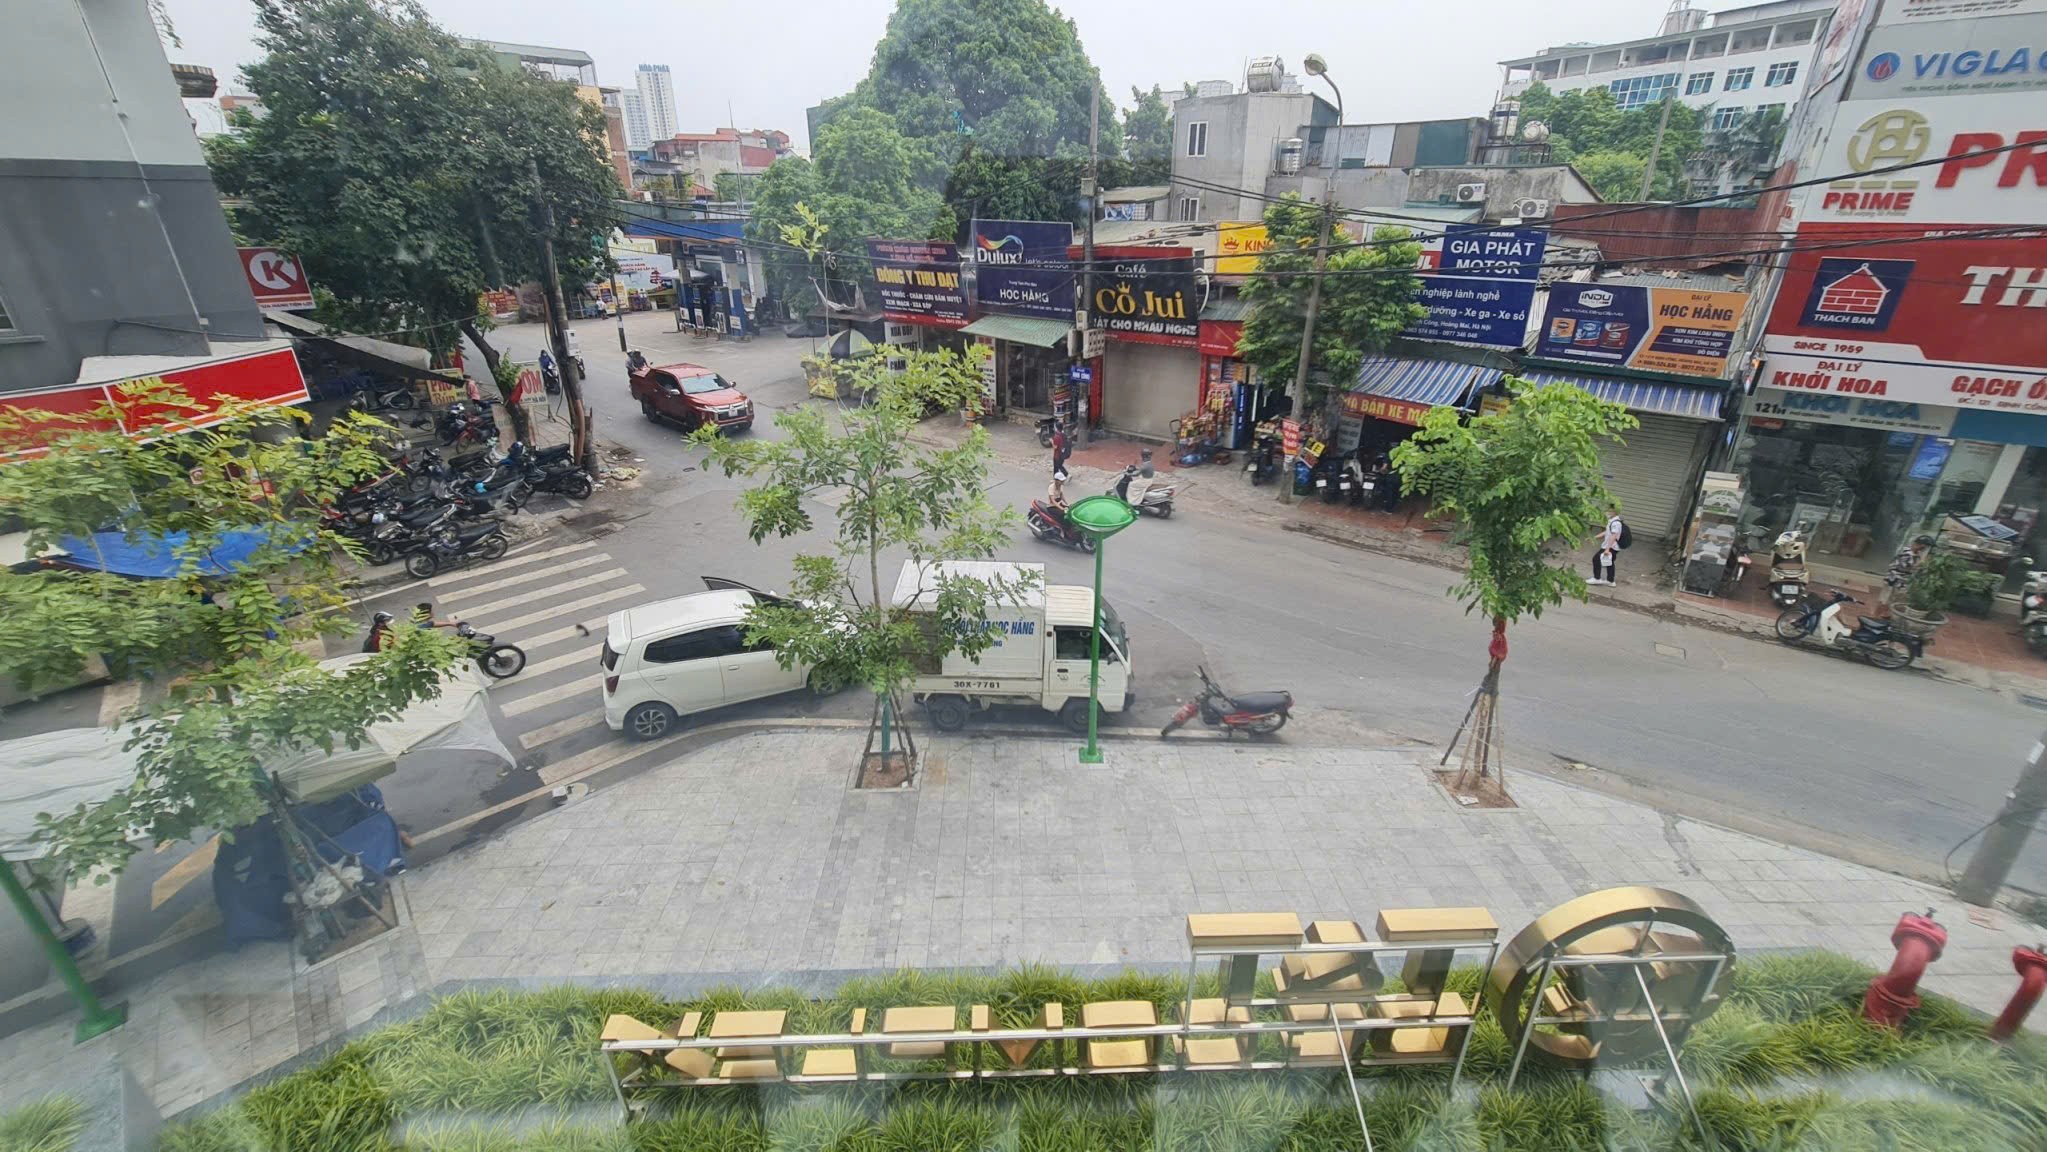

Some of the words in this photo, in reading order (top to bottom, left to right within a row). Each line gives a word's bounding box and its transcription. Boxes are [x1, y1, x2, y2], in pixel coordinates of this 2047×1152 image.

[1822, 192, 1915, 210] PRIME
[977, 247, 1017, 264] Dulux
[1450, 240, 1480, 254] GIA
[1485, 239, 1536, 256] PHÁT
[261, 260, 296, 287] K
[1115, 264, 1147, 278] Café
[1456, 259, 1521, 275] MOTOR
[1422, 288, 1452, 299] nghiệp
[1142, 290, 1185, 319] Jui
[1660, 304, 1689, 320] HỌC
[1464, 308, 1477, 317] Xe
[1479, 310, 1490, 319] ga
[1498, 310, 1511, 320] Xe
[1814, 314, 1851, 323] THACH
[1851, 316, 1876, 325] BAN
[1794, 341, 1827, 351] SINCE
[1834, 344, 1863, 354] 1959
[1817, 361, 1844, 373] ĐẠI
[1845, 361, 1863, 372] LÝ
[1772, 371, 1831, 390] KHỞI
[1837, 377, 1888, 395] HOA
[1951, 376, 2023, 397] GẠCH
